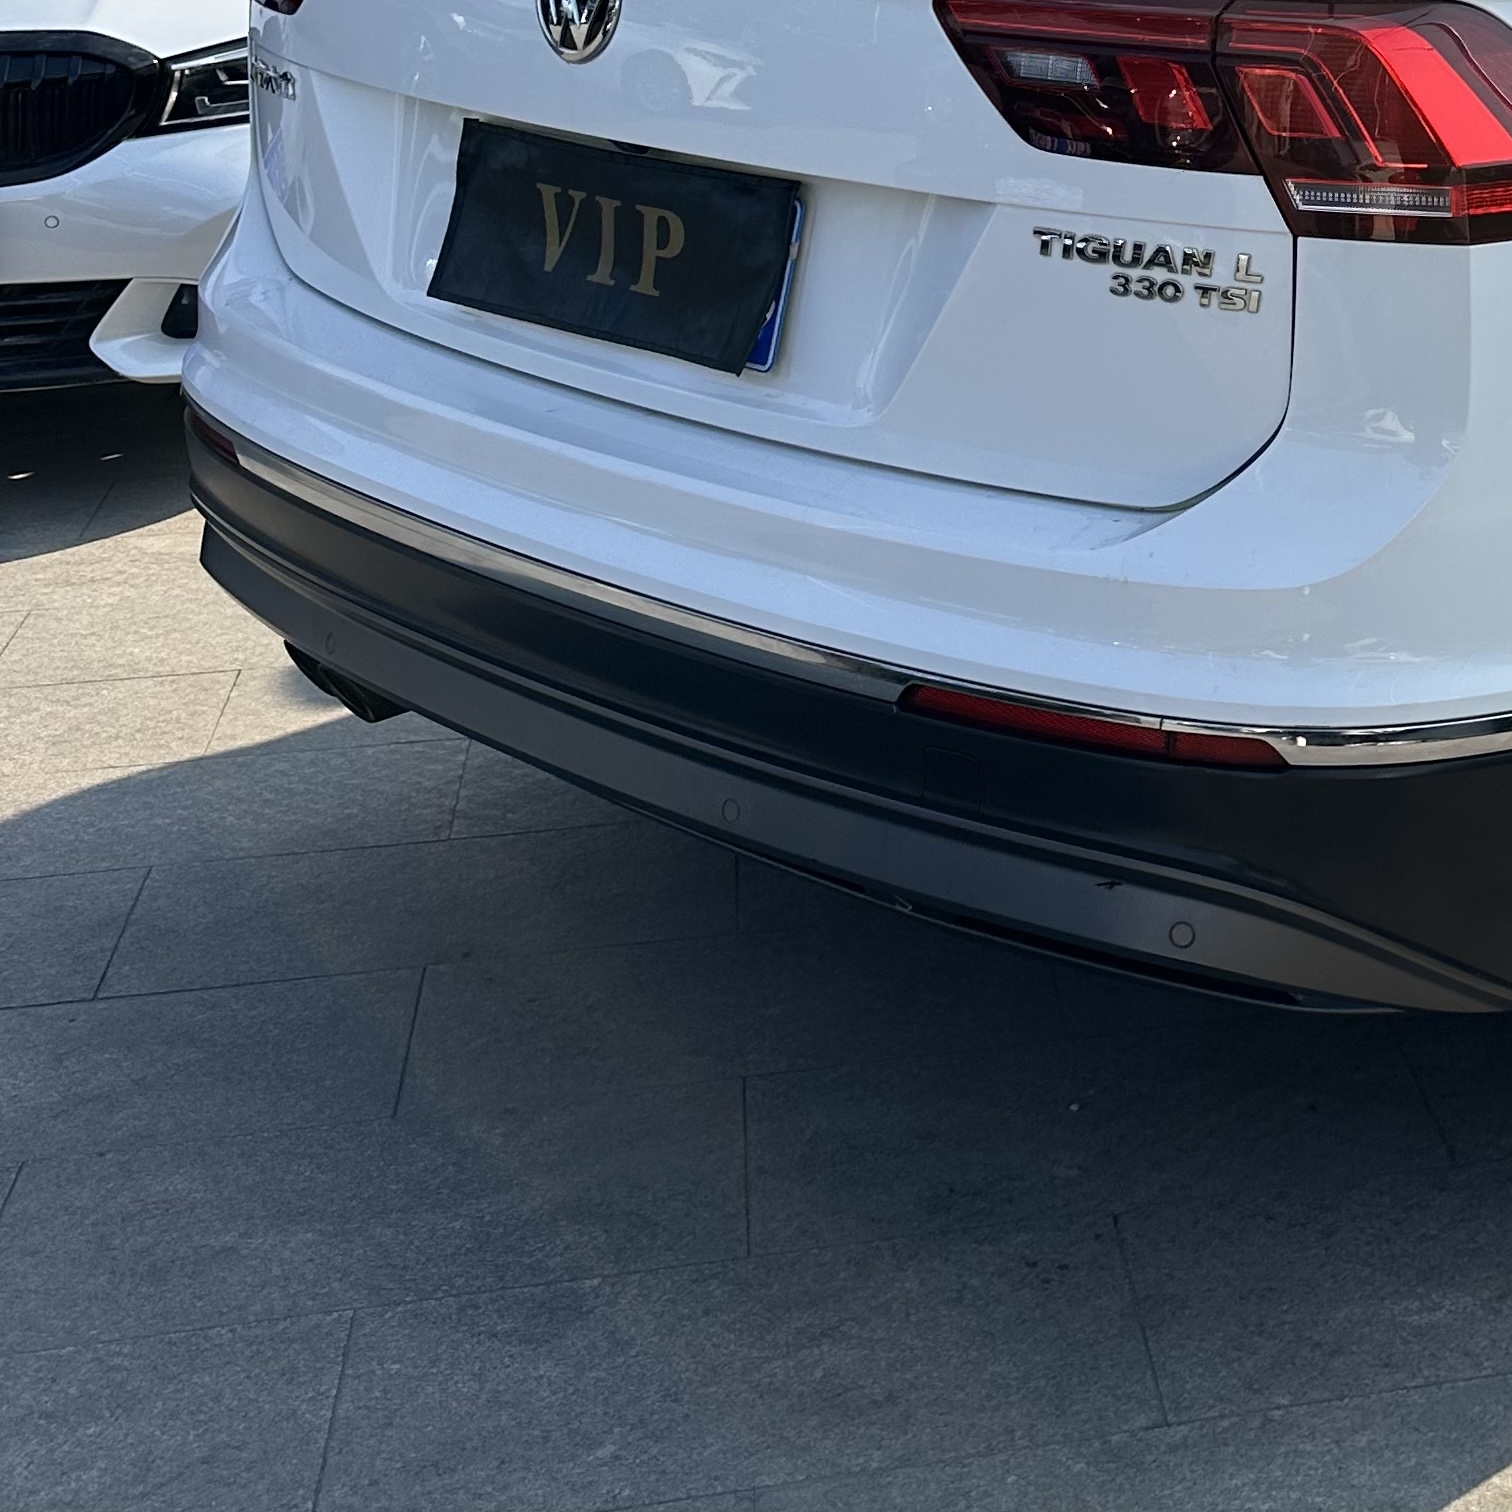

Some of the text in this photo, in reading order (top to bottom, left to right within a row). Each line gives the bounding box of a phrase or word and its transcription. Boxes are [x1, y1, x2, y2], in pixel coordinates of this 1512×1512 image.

[536, 182, 685, 297] VIP
[1033, 226, 1264, 284] TIGUAN L
[1109, 272, 1262, 314] 330 TSI
